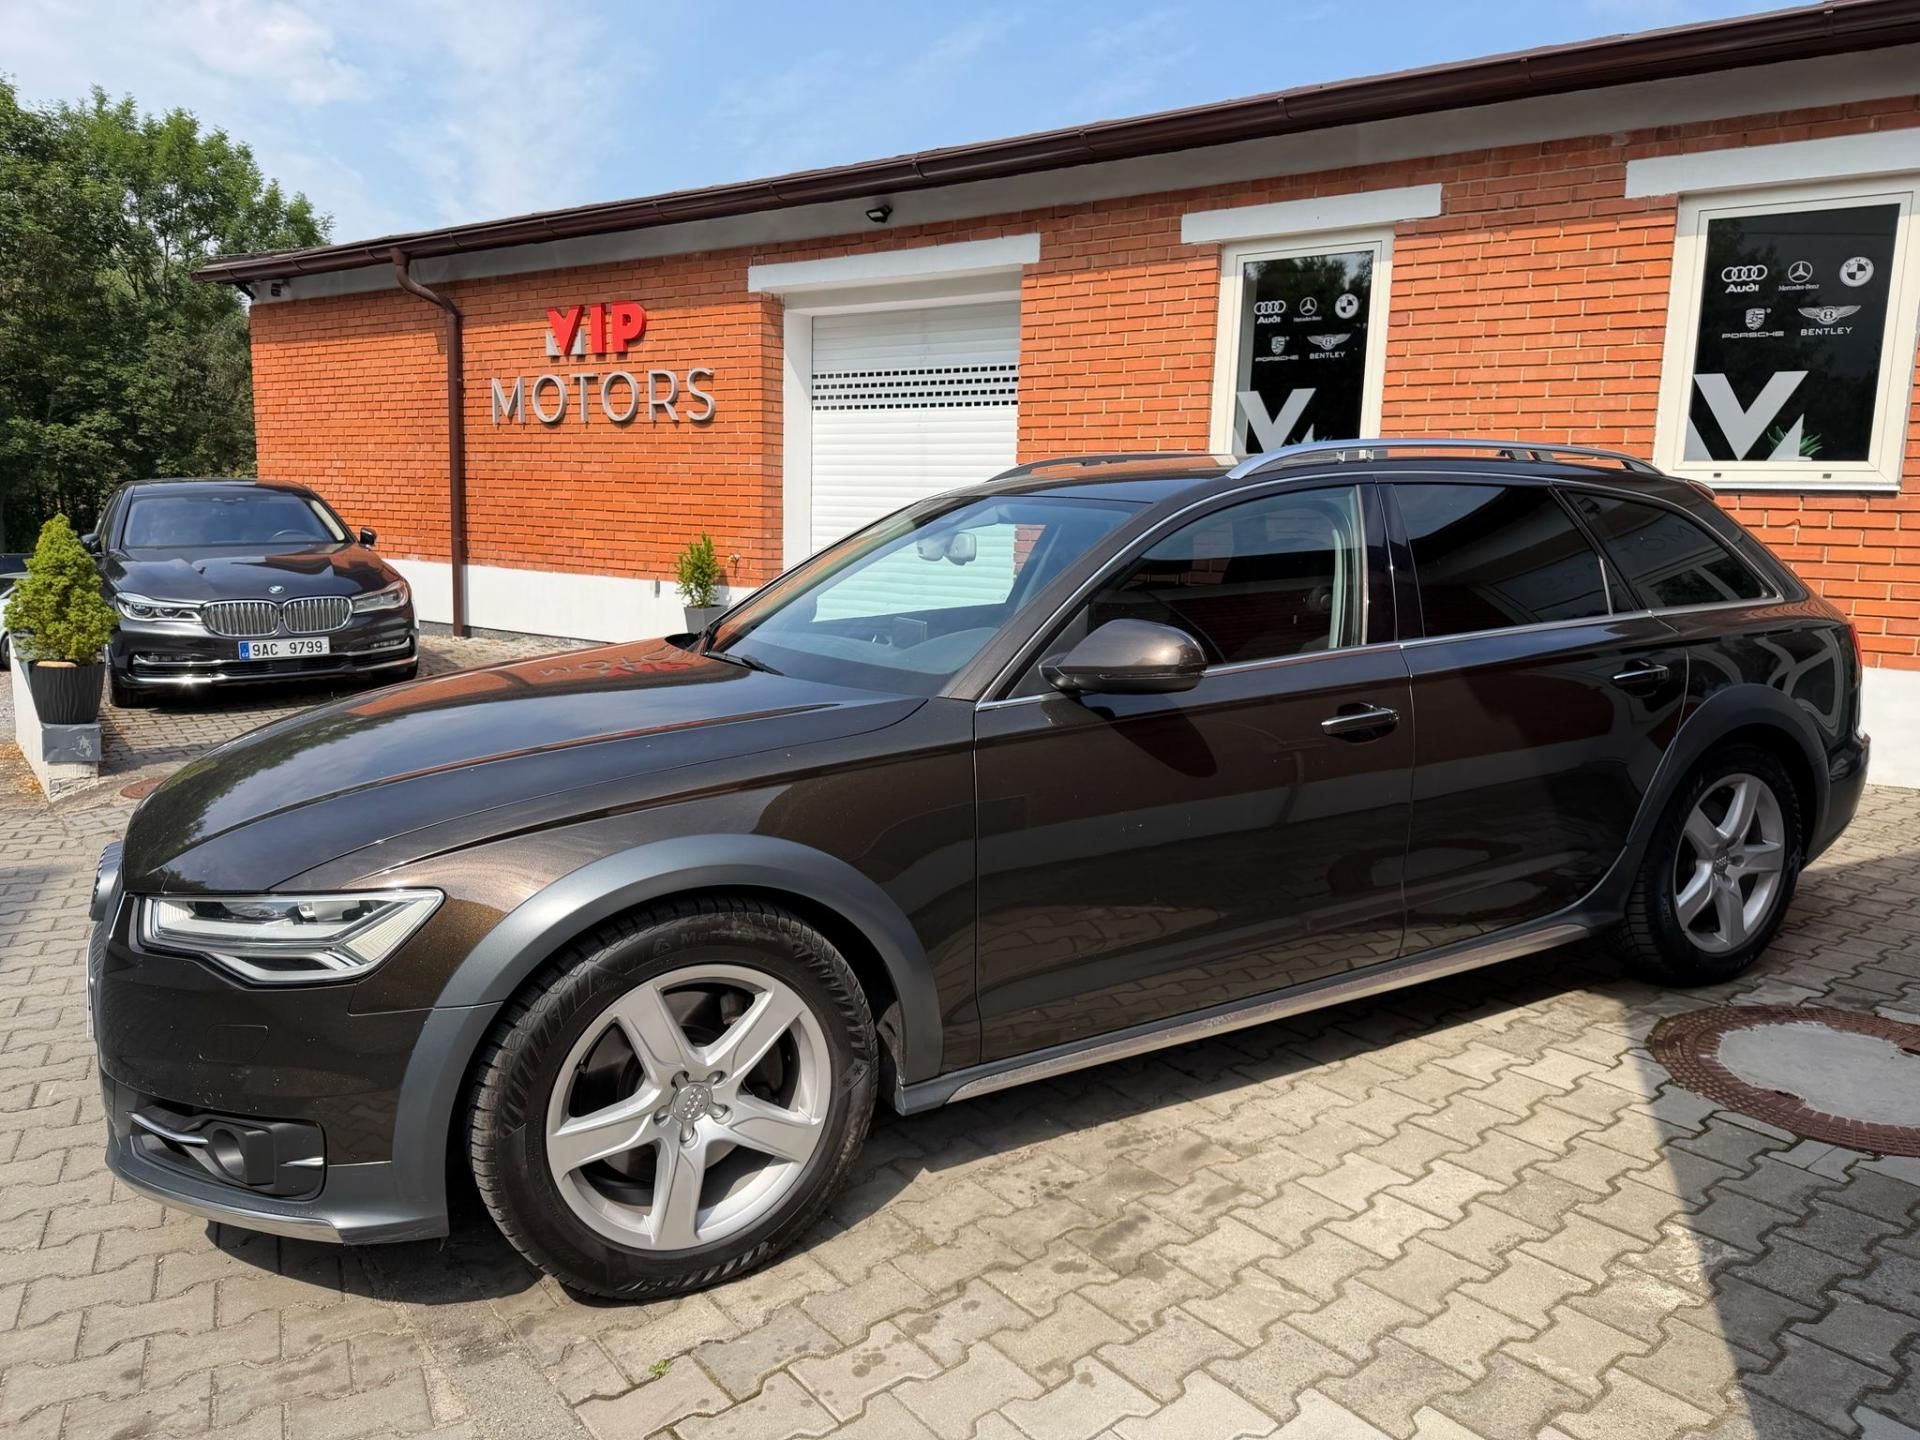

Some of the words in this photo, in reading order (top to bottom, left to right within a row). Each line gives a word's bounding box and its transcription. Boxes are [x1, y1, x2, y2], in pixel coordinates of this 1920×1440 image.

[1725, 283, 1760, 294] Audi
[1257, 315, 1282, 324] Audi
[546, 302, 647, 356] VIP
[1721, 330, 1785, 339] PORSCHE
[1800, 326, 1853, 337] BENTLEY
[1309, 352, 1346, 360] BENTLEY
[491, 368, 715, 425] MOTORS
[252, 643, 279, 657] 9AC
[289, 640, 323, 655] 9799
